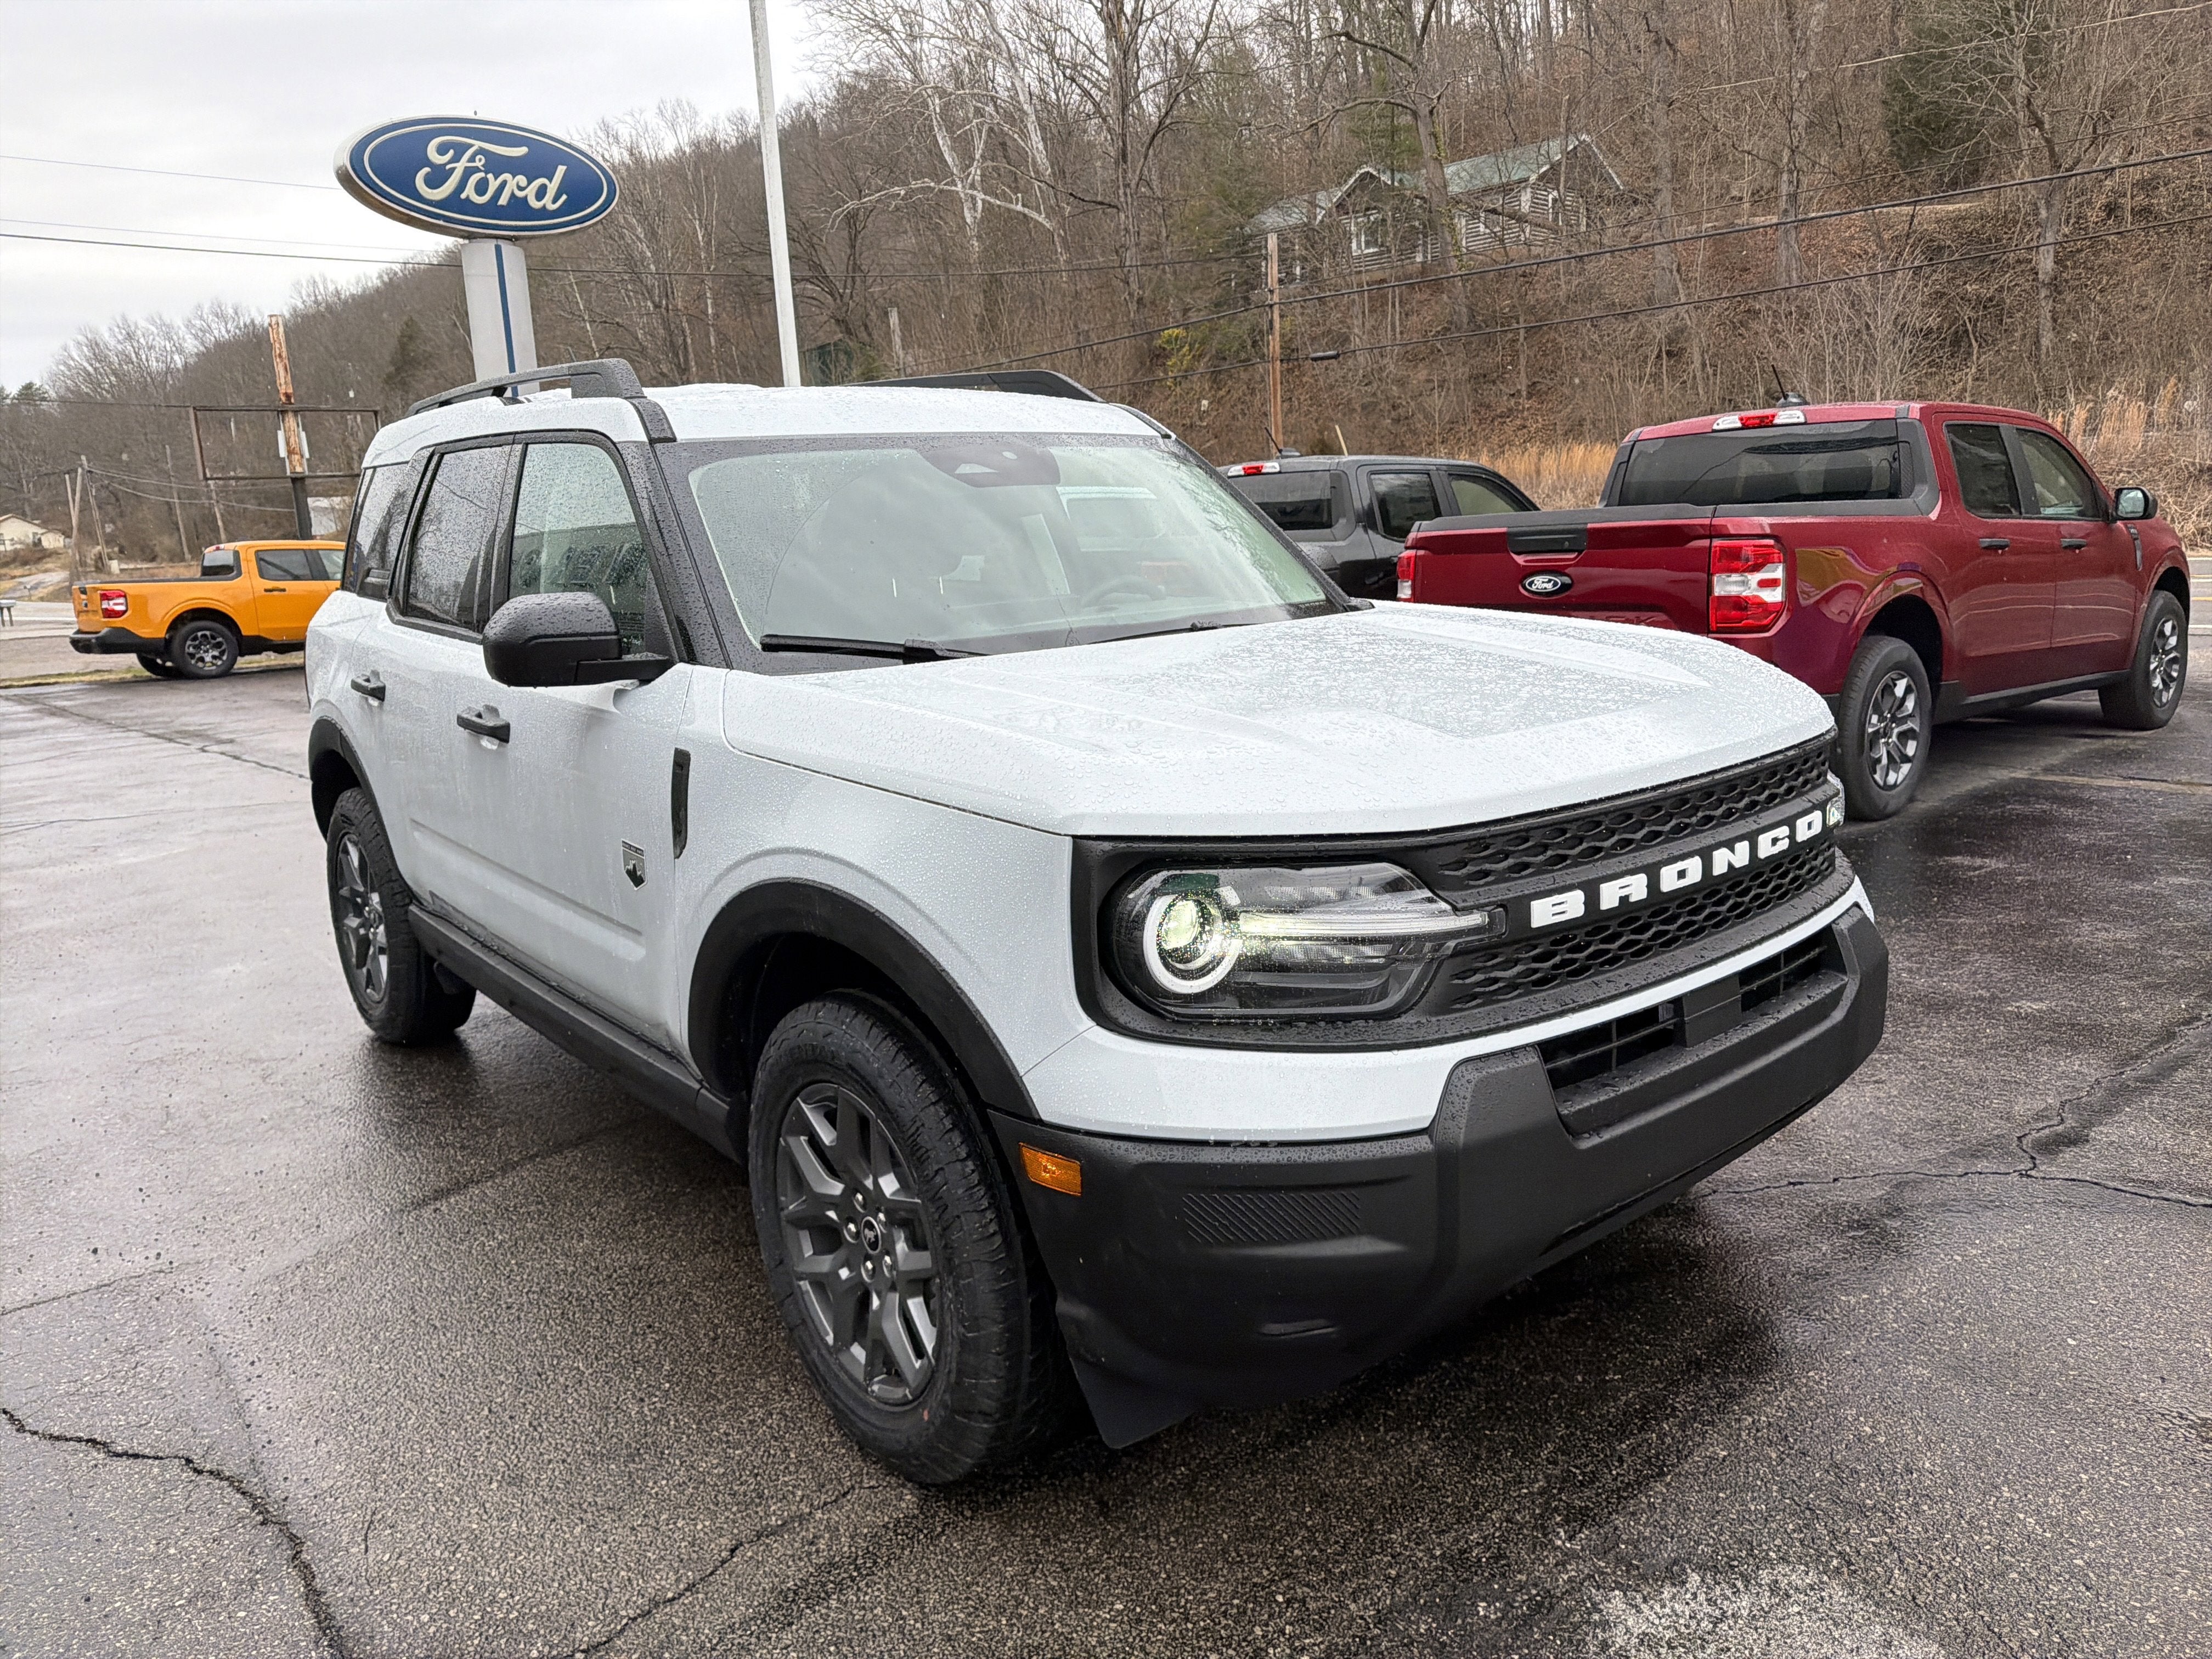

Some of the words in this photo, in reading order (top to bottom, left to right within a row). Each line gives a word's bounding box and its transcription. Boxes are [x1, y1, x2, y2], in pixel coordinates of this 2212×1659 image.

[416, 136, 567, 210] Ford
[1532, 578, 1554, 589] Ford
[1531, 810, 1822, 928] BRONCO
